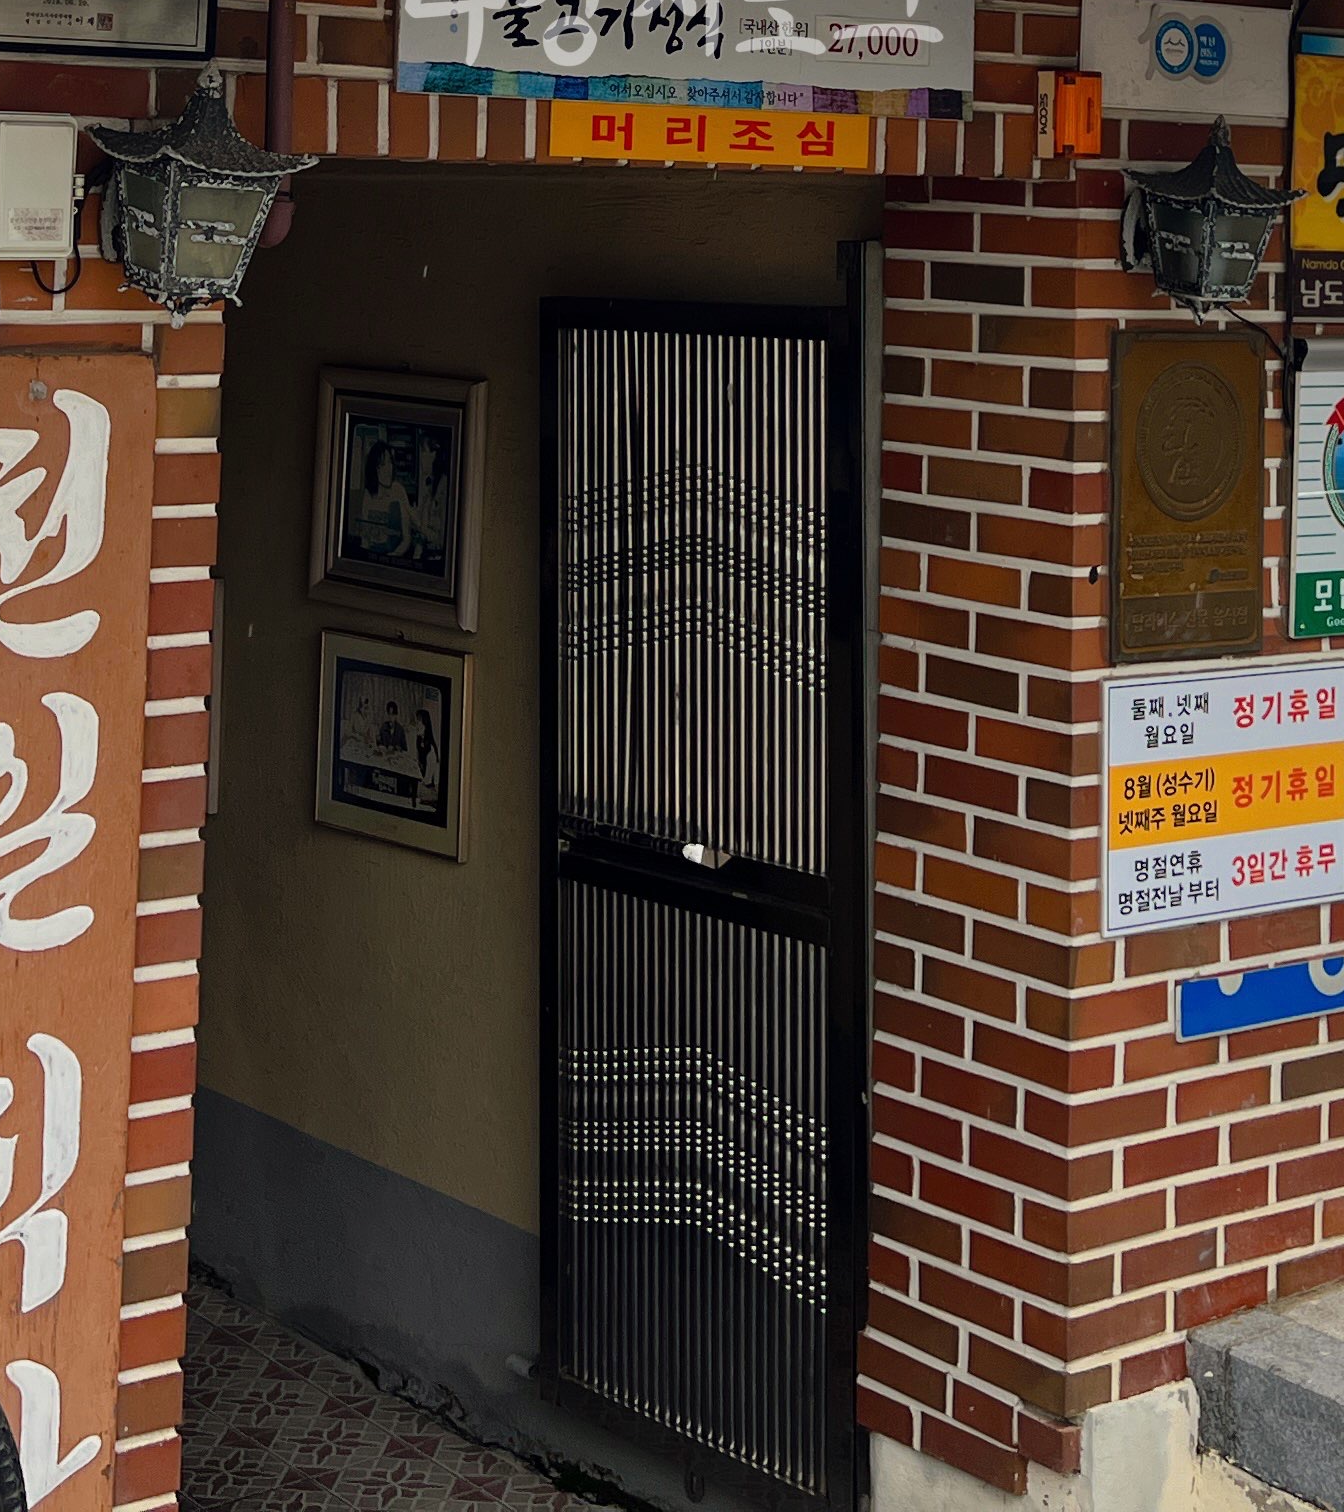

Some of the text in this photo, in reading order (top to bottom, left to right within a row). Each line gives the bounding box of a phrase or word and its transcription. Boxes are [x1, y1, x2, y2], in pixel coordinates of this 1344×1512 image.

[827, 23, 919, 60] 27,000
[591, 112, 836, 157] 머리조심
[1301, 257, 1337, 272] Namdo
[1232, 686, 1337, 729] 정기휴일
[1144, 721, 1196, 749] 월요일
[1123, 763, 1337, 809] 8월 (성수기) 정기휴일
[1118, 799, 1219, 836] 넷째주 월요일
[1133, 843, 1337, 888] 명절연휴 3일간 휴무
[1118, 877, 1221, 916] 명절전날 부터
